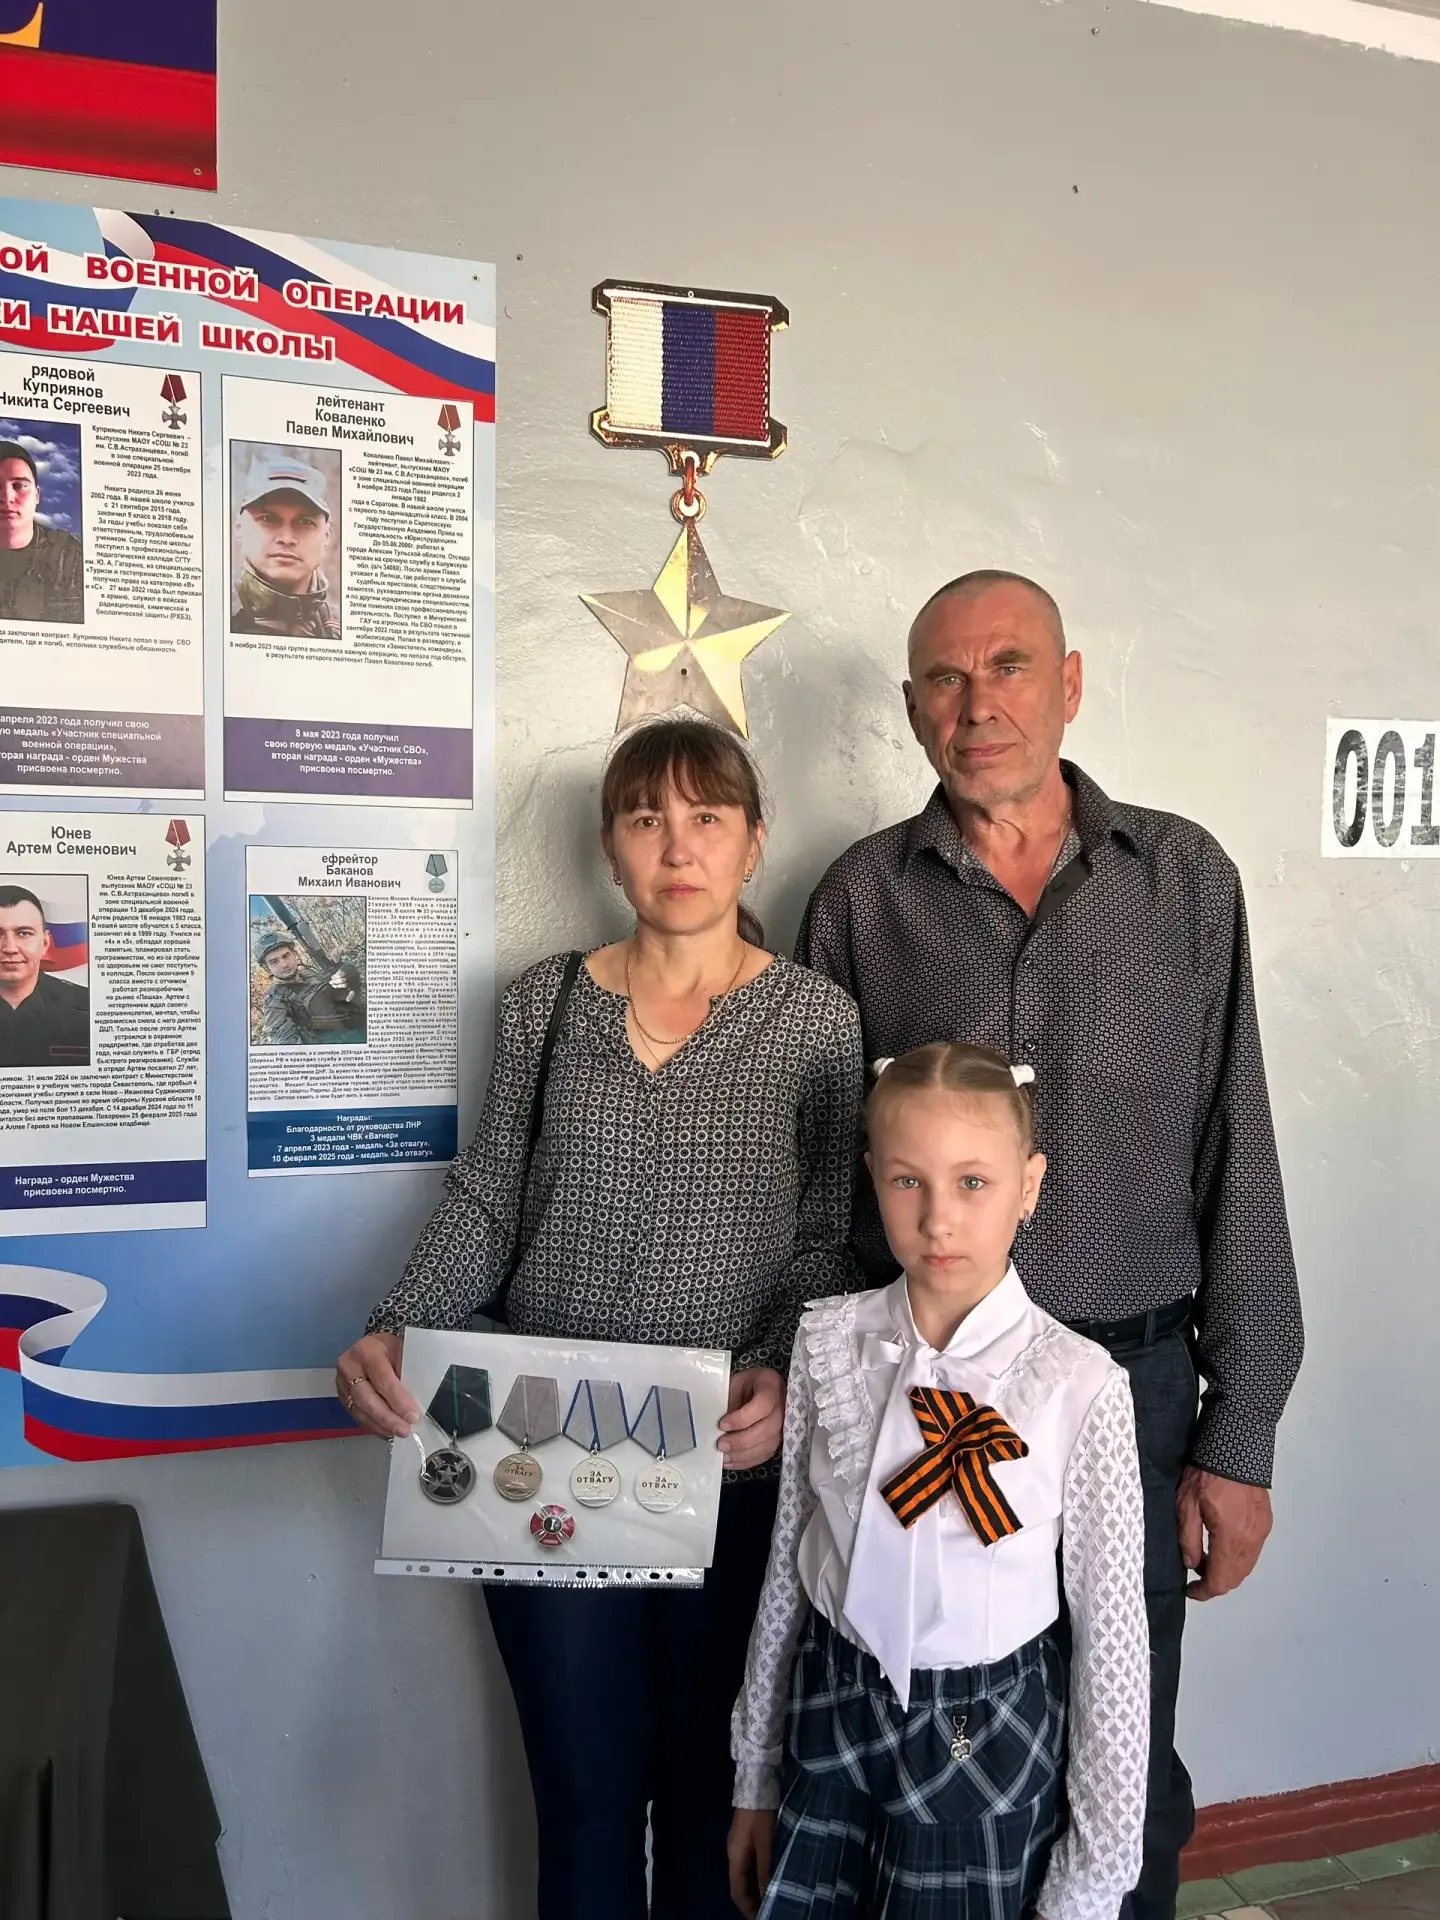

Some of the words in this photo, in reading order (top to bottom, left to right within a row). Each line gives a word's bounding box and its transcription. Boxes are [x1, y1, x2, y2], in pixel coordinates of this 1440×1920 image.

[0, 244, 48, 273] ОЙ
[87, 256, 255, 299] ВОЕННОЙ
[286, 282, 464, 325] ОПЕРАЦИИ
[51, 307, 179, 343] НАШЕЙ
[202, 325, 332, 361] ШКОЛЫ
[32, 366, 94, 382] рядовой
[23, 378, 103, 398] Куприянов
[53, 396, 130, 417] Сергеевич
[316, 396, 385, 412] лейтенант
[316, 408, 386, 427] Коваленко
[286, 420, 327, 437] Павел
[332, 425, 414, 446] Михайлович
[36, 715, 58, 725] 2023
[60, 718, 81, 727] года
[84, 719, 123, 729] получил
[125, 720, 149, 728] свою
[14, 728, 49, 737] медаль
[52, 728, 99, 738] «Участник
[101, 730, 162, 741] специальной
[296, 729, 300, 737] 8
[321, 730, 340, 739] 2023
[342, 733, 361, 741] года
[363, 734, 399, 744] получил
[290, 742, 323, 751] первую
[325, 744, 356, 752] медаль
[359, 743, 402, 753] «Участник
[26, 753, 64, 762] награда
[72, 755, 100, 764] орден
[102, 754, 147, 765] Мужества
[272, 753, 301, 762] вторая
[304, 754, 338, 763] награда
[344, 756, 370, 765] орден
[372, 755, 422, 767] «Мужества»
[17, 765, 67, 774] присвоена
[300, 766, 345, 774] присвоена
[1333, 729, 1440, 847] 001
[52, 826, 91, 840] Юнев
[6, 841, 52, 857] Артем
[57, 842, 136, 855] Семенович
[322, 853, 378, 867] ефрейтор
[326, 865, 373, 876] Баканов
[298, 876, 342, 887] Михаил
[346, 877, 401, 888] Иванович
[337, 1114, 372, 1123] Награды:
[287, 1124, 345, 1134] Благодарность
[357, 1123, 404, 1132] руководства
[364, 1132, 398, 1140] «Вагнер»
[282, 1154, 317, 1163] февраля
[15, 1176, 52, 1186] Награда
[60, 1176, 88, 1185] орден
[91, 1173, 134, 1184] Мужества
[24, 1188, 73, 1197] присвоена
